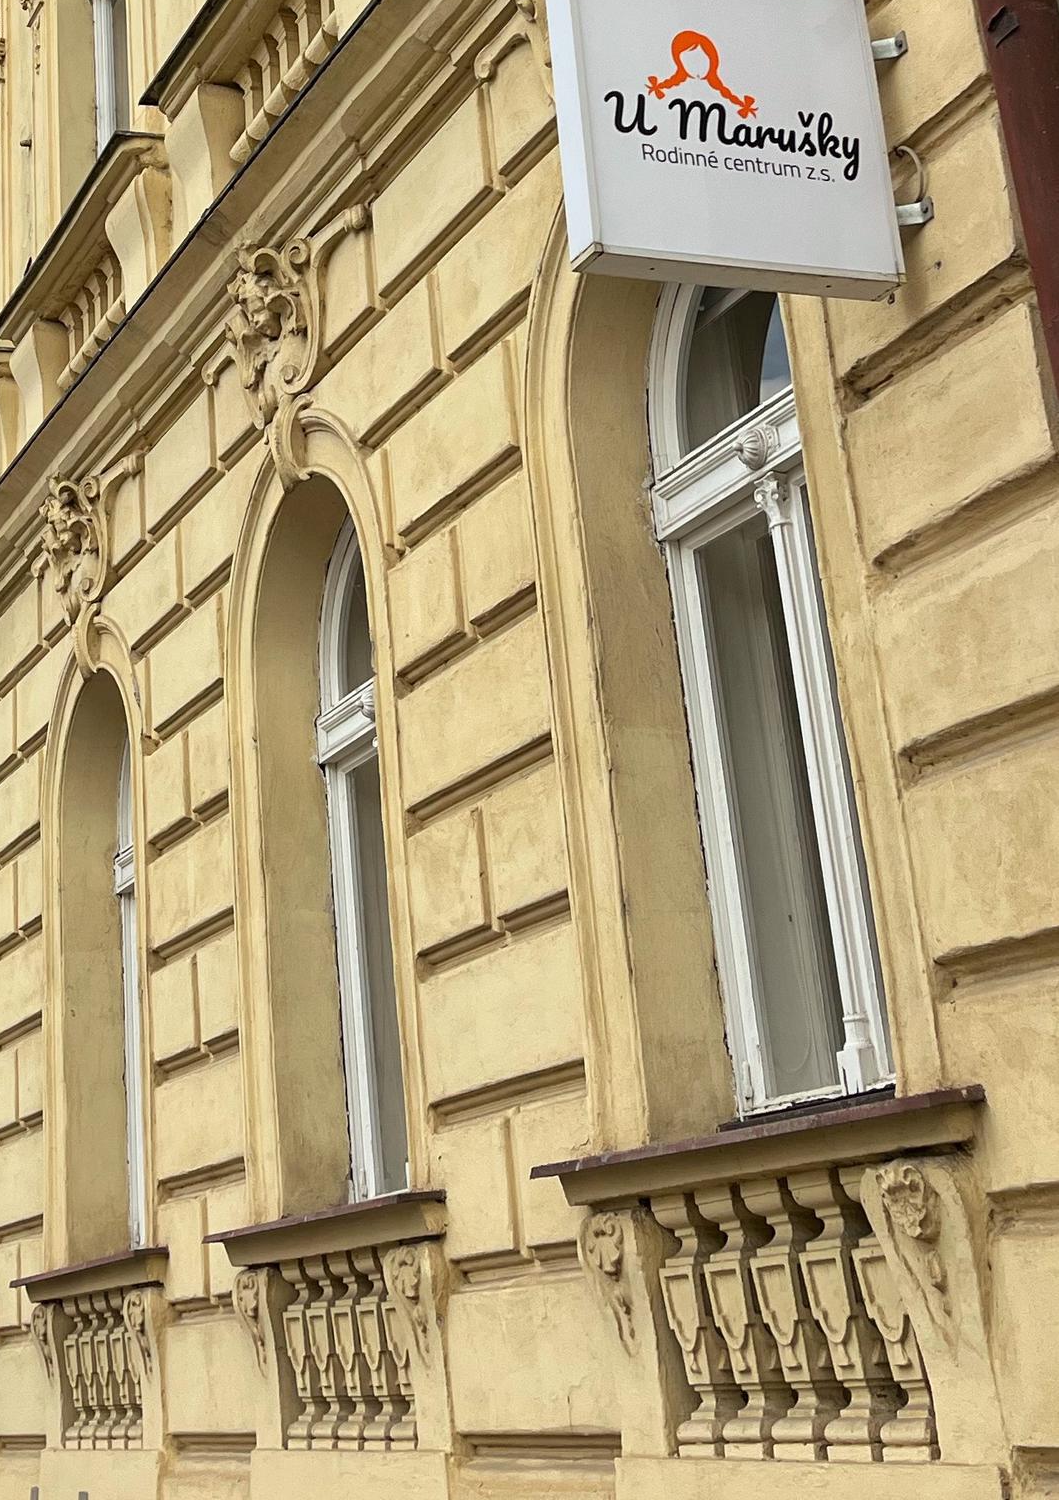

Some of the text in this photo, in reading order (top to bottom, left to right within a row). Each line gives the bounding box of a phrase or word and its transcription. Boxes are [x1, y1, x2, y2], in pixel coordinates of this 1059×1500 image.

[604, 91, 860, 181] U Marušky
[641, 143, 836, 182] Rodinné centrum z.s.
